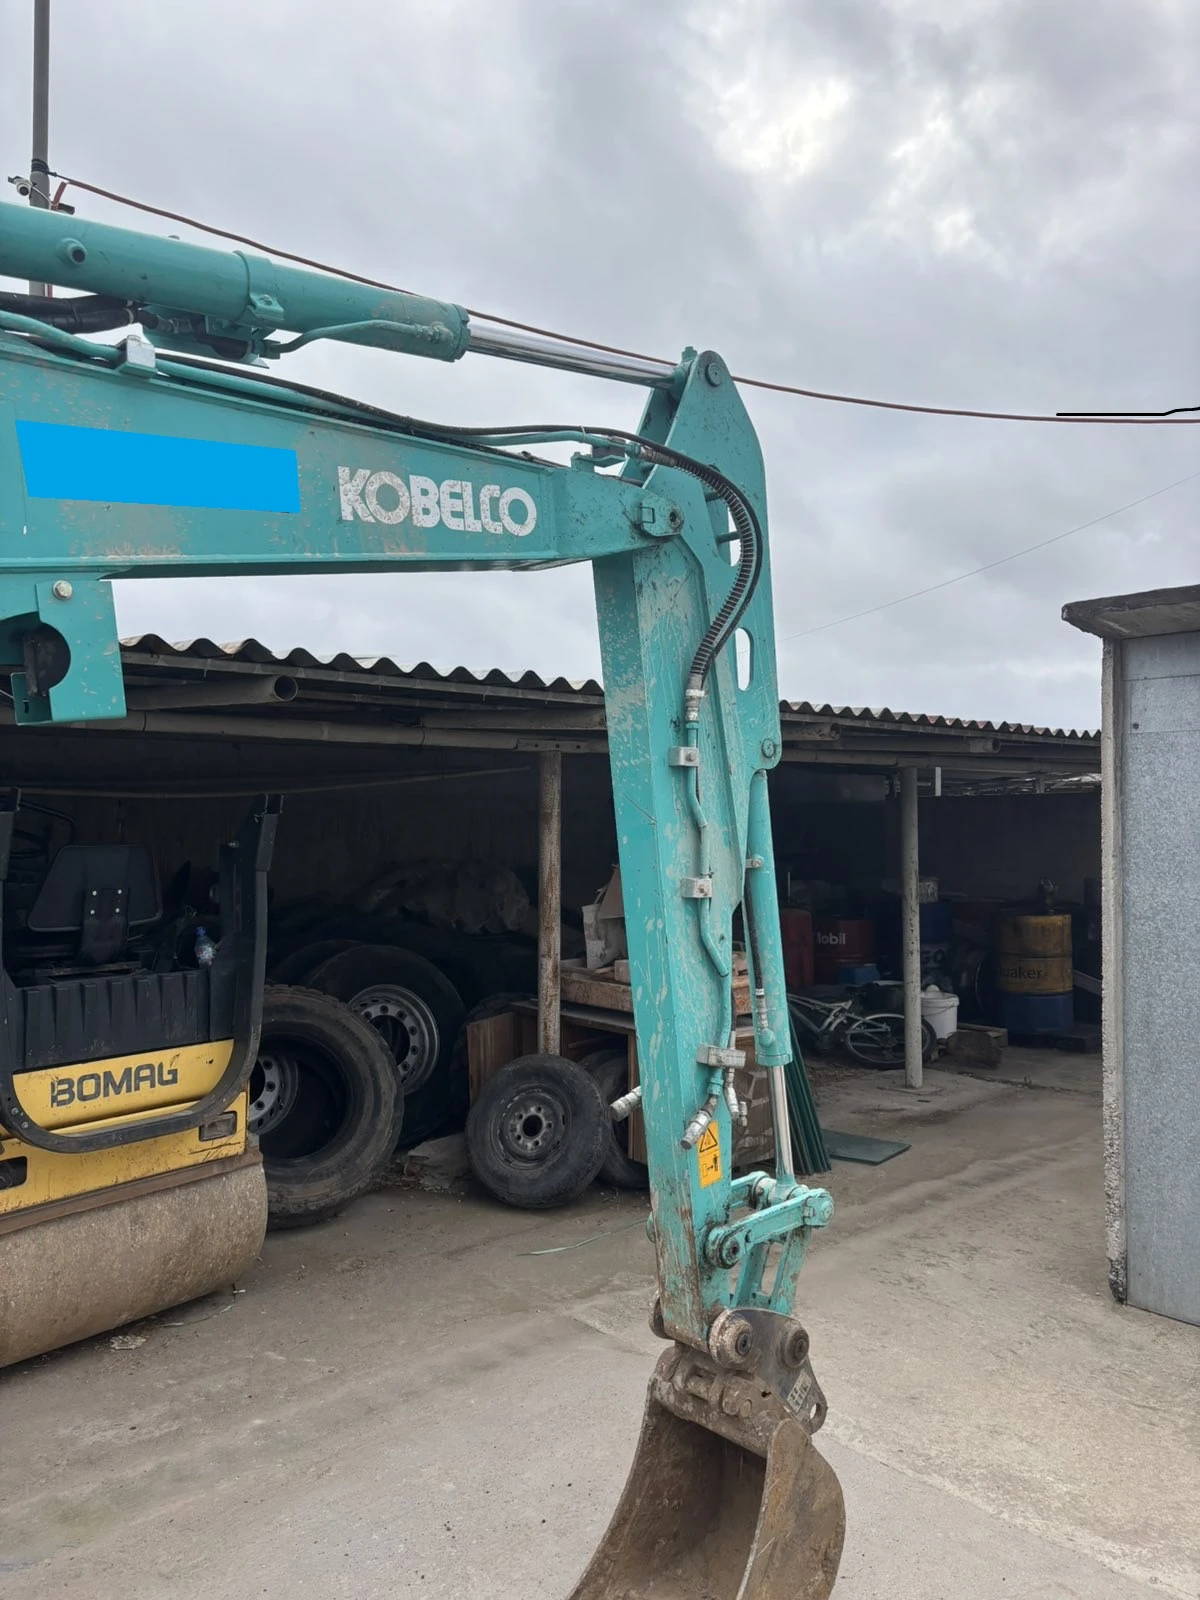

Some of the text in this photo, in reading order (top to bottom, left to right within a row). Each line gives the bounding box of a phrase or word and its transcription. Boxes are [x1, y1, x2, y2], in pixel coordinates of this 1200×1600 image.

[338, 466, 537, 536] KOBELCO
[999, 965, 1043, 980] uaker
[50, 1061, 178, 1108] BOMAG
